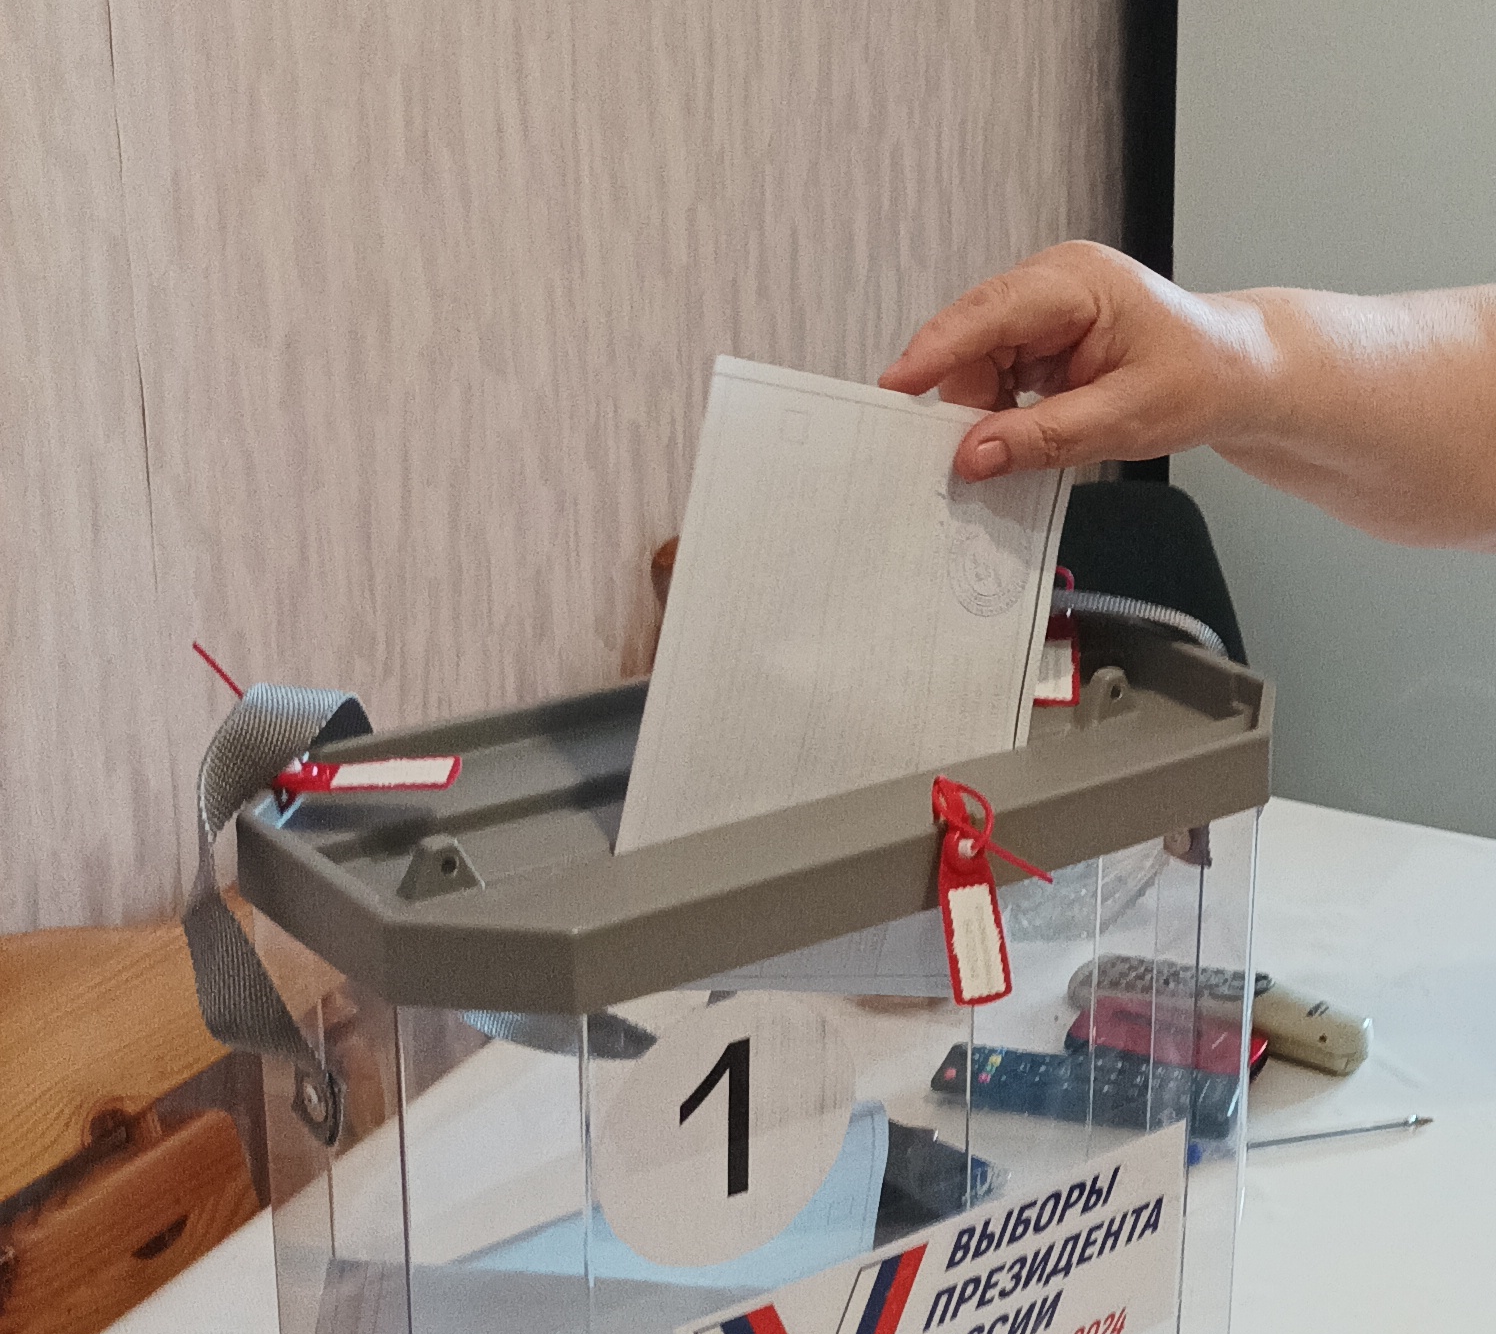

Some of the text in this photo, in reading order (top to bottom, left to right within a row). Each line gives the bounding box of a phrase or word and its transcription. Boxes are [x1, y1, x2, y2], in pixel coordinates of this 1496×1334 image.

[678, 1035, 752, 1198] 1
[923, 1194, 1164, 1334] ПРЕЗИДЕНТА
[945, 1164, 1122, 1271] ВЫБОРЫ
